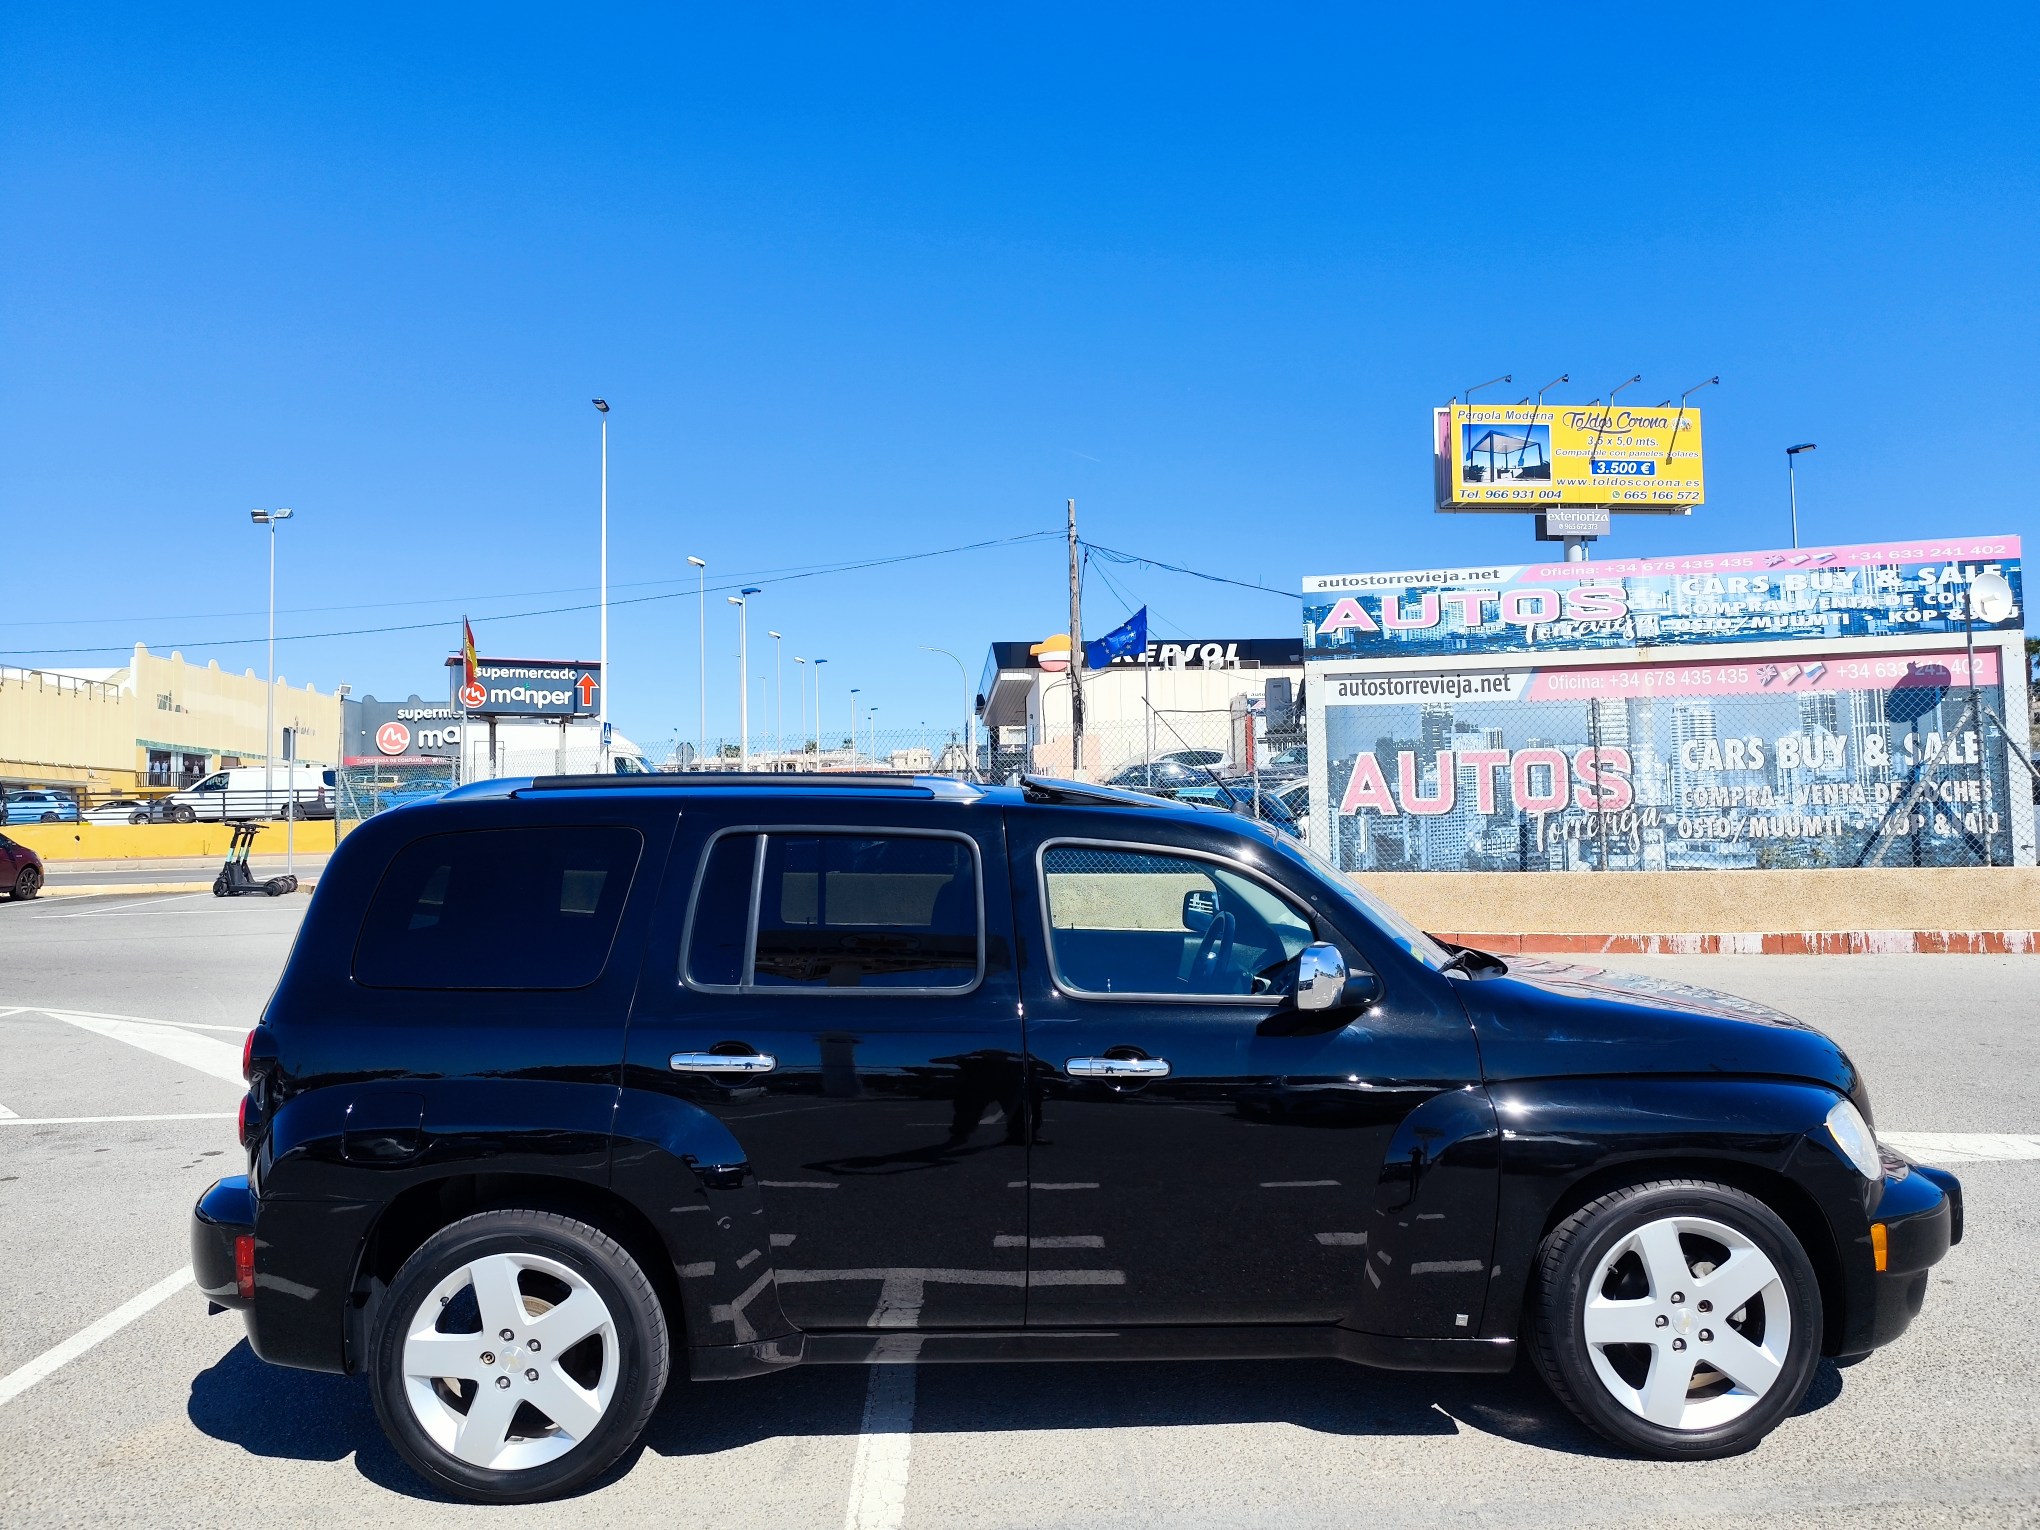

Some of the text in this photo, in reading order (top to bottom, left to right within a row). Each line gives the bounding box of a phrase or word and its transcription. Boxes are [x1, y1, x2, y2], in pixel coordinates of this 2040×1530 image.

[1457, 410, 1554, 421] Pergola Moderna
[1562, 411, 1668, 432] Toldos Corona
[1606, 437, 1612, 445] x
[1616, 436, 1632, 447] 5,0
[1636, 436, 1659, 446] mts.
[1555, 449, 1606, 458] Compatible
[1629, 449, 1663, 458] paneles
[1667, 449, 1699, 458] solares
[1596, 462, 1651, 474] 3.500 €
[1556, 477, 1700, 487] www.toldoscorona.es
[1460, 490, 1562, 499] Tel. 966 931 004
[1624, 491, 1700, 500] 665 166 572
[1547, 511, 1609, 522] exterioriza
[1848, 545, 2006, 561] +34 633 241 402
[1540, 557, 1754, 577] Oficina: +34 678 435 435
[1317, 569, 1500, 588] autostorrevieja.net
[1682, 575, 1771, 596] CARS
[1784, 571, 1860, 591] BUY
[1875, 569, 1903, 587] &
[1885, 593, 1914, 606] DE
[1316, 586, 1629, 634] AUTOS
[1888, 607, 1938, 623] KÖP
[475, 667, 578, 680] supermercado
[1548, 668, 1749, 690] Oficina: +34 678 435 435
[1837, 663, 1870, 679] +34
[1875, 662, 1909, 678] 633
[1338, 673, 1512, 698] autostorrevieja.net
[490, 686, 573, 709] manper
[1681, 731, 1979, 771] CARS BUY & SALE
[1338, 746, 1634, 816] AUTOS
[1682, 786, 1776, 807] COMPRA
[1798, 783, 1866, 805] VENTA
[1874, 782, 1905, 803] DE
[1527, 804, 1662, 854] Torrevieja
